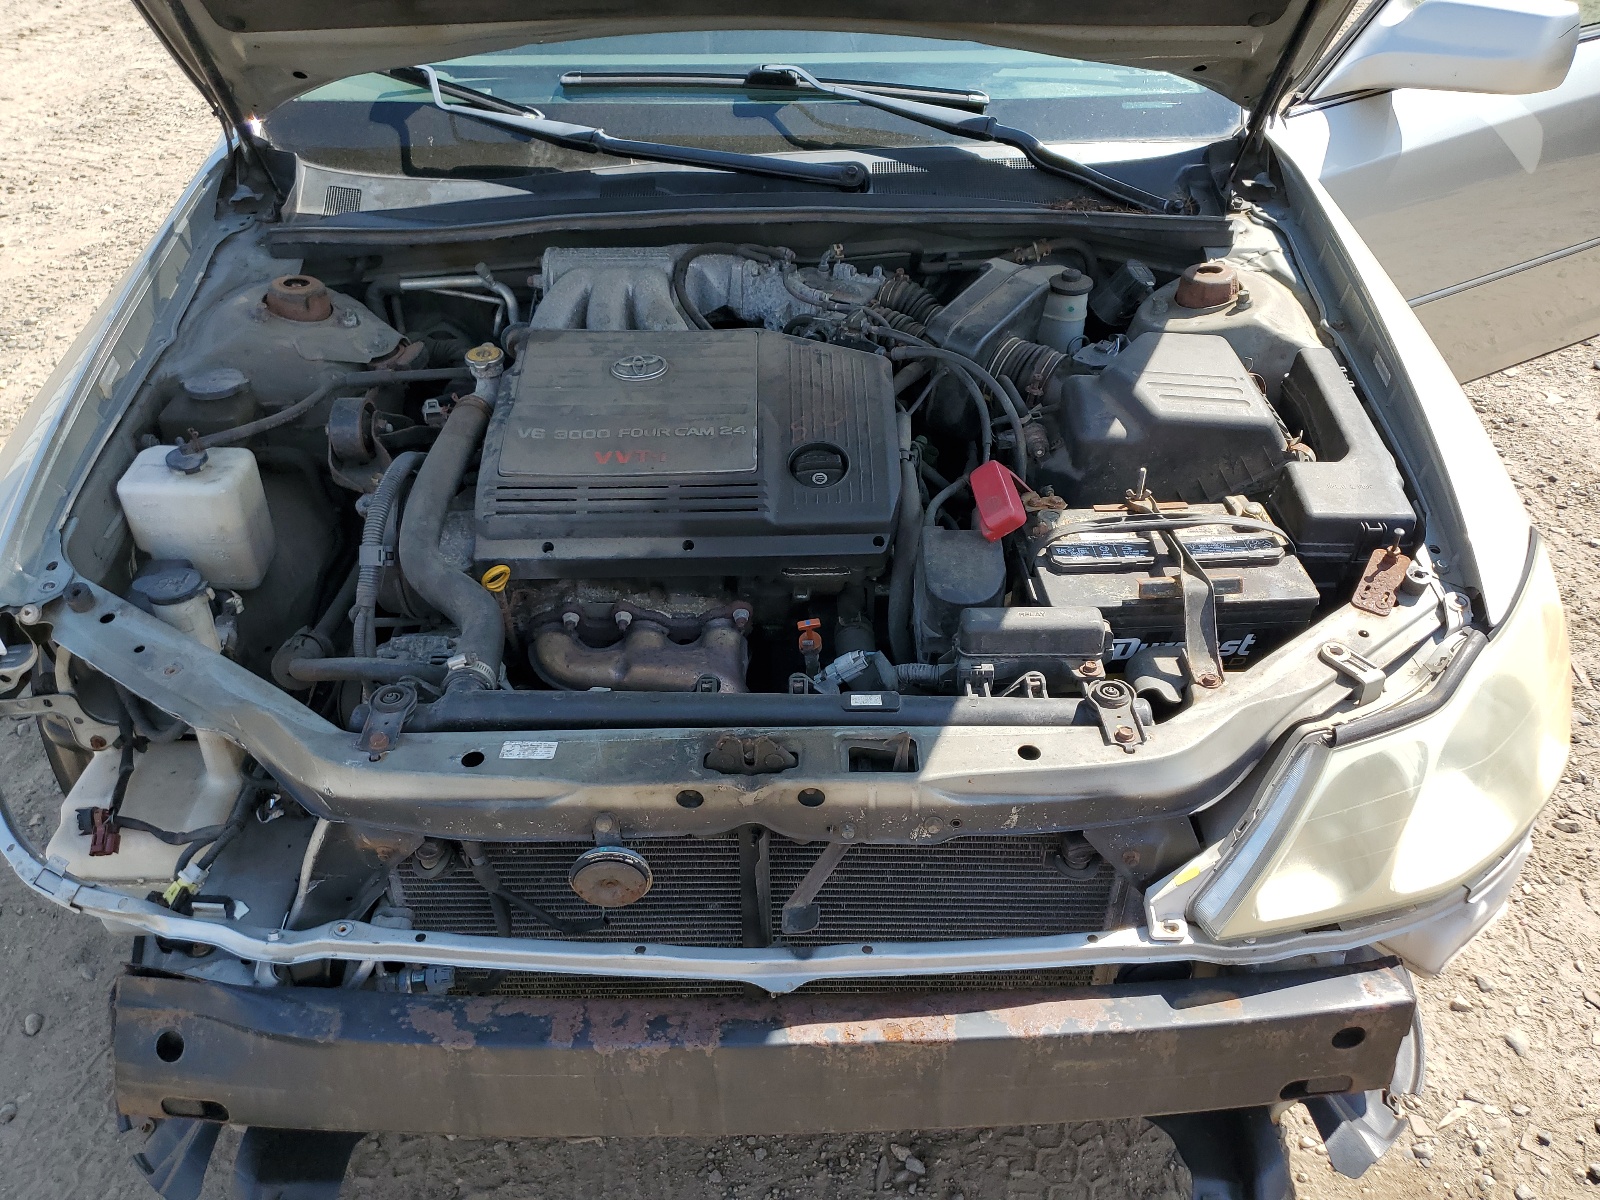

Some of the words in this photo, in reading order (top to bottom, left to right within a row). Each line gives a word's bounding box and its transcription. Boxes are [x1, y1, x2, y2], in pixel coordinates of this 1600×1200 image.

[517, 427, 546, 439] V6
[554, 429, 611, 440] 3000
[618, 428, 671, 438] FOUR
[674, 426, 715, 437] CAM
[719, 425, 747, 436] 24
